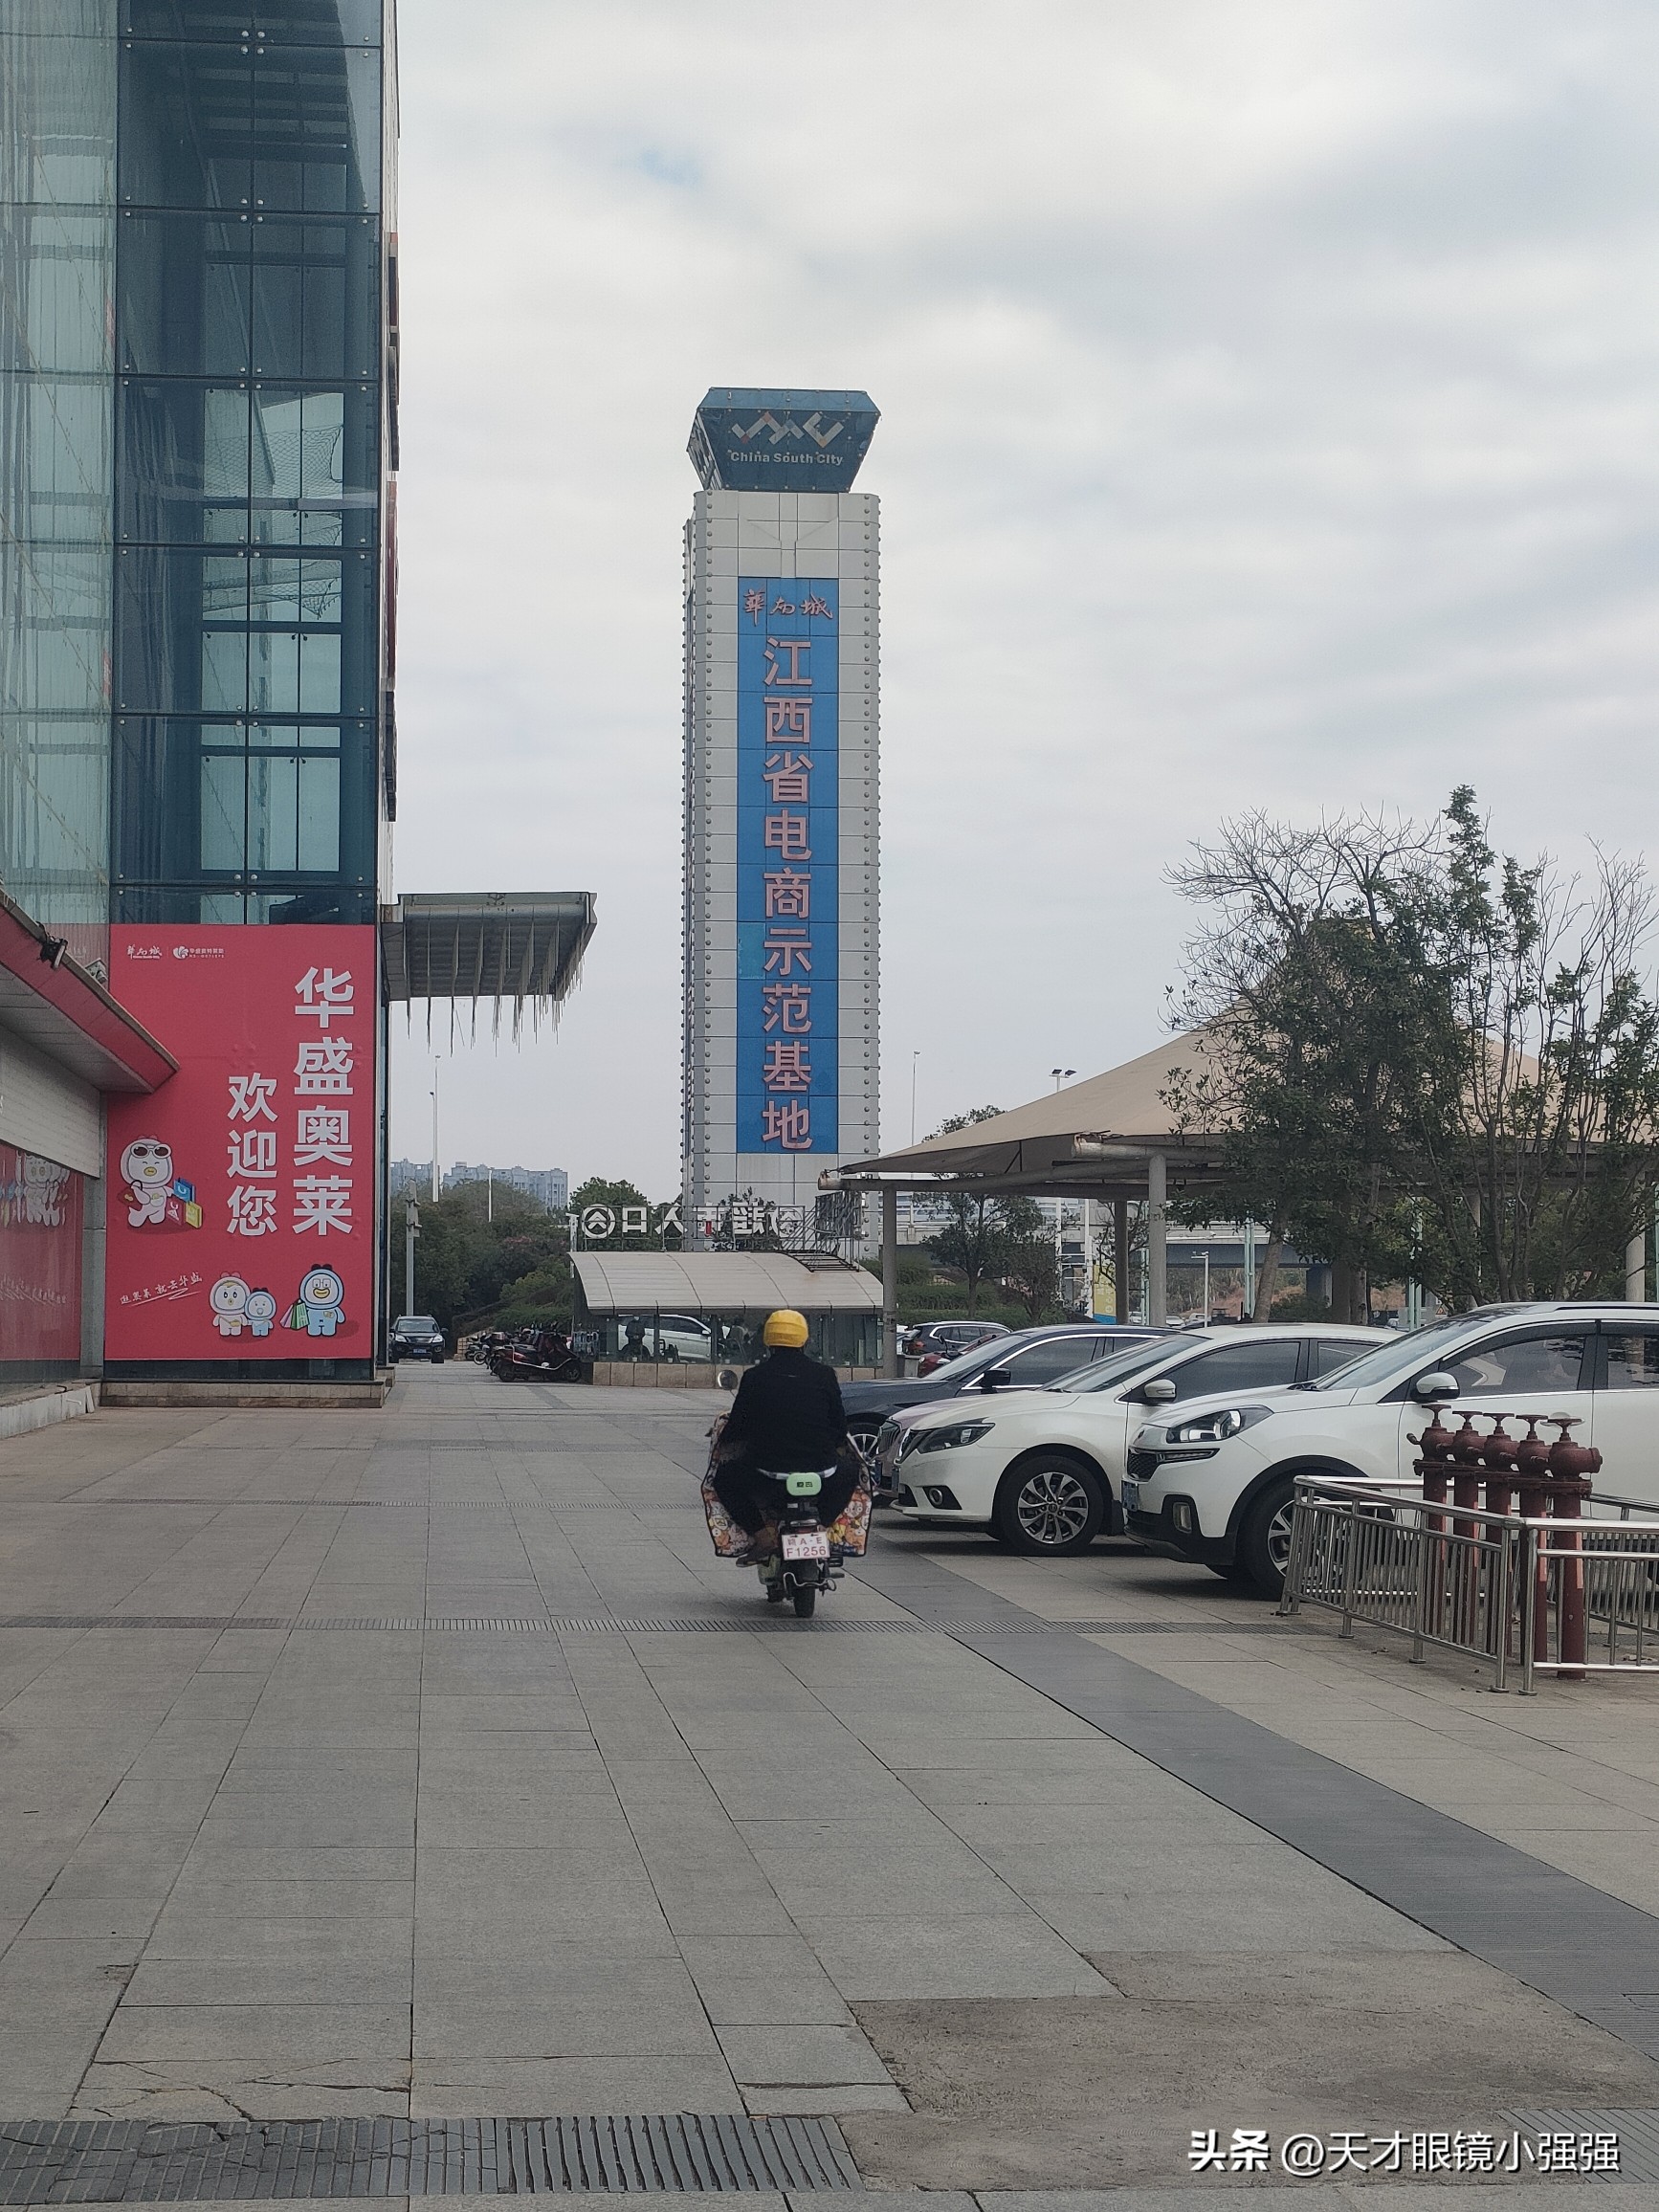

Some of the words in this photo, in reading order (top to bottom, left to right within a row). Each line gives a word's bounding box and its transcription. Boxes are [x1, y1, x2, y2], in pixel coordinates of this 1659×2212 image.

[730, 452, 770, 463] China
[773, 453, 813, 464] South
[816, 453, 844, 466] City
[763, 637, 813, 1150] 江西省电商示范基地
[226, 1072, 278, 1236] 欢迎您
[293, 966, 355, 1236] 华盛奥莱
[786, 1546, 826, 1559] F1256
